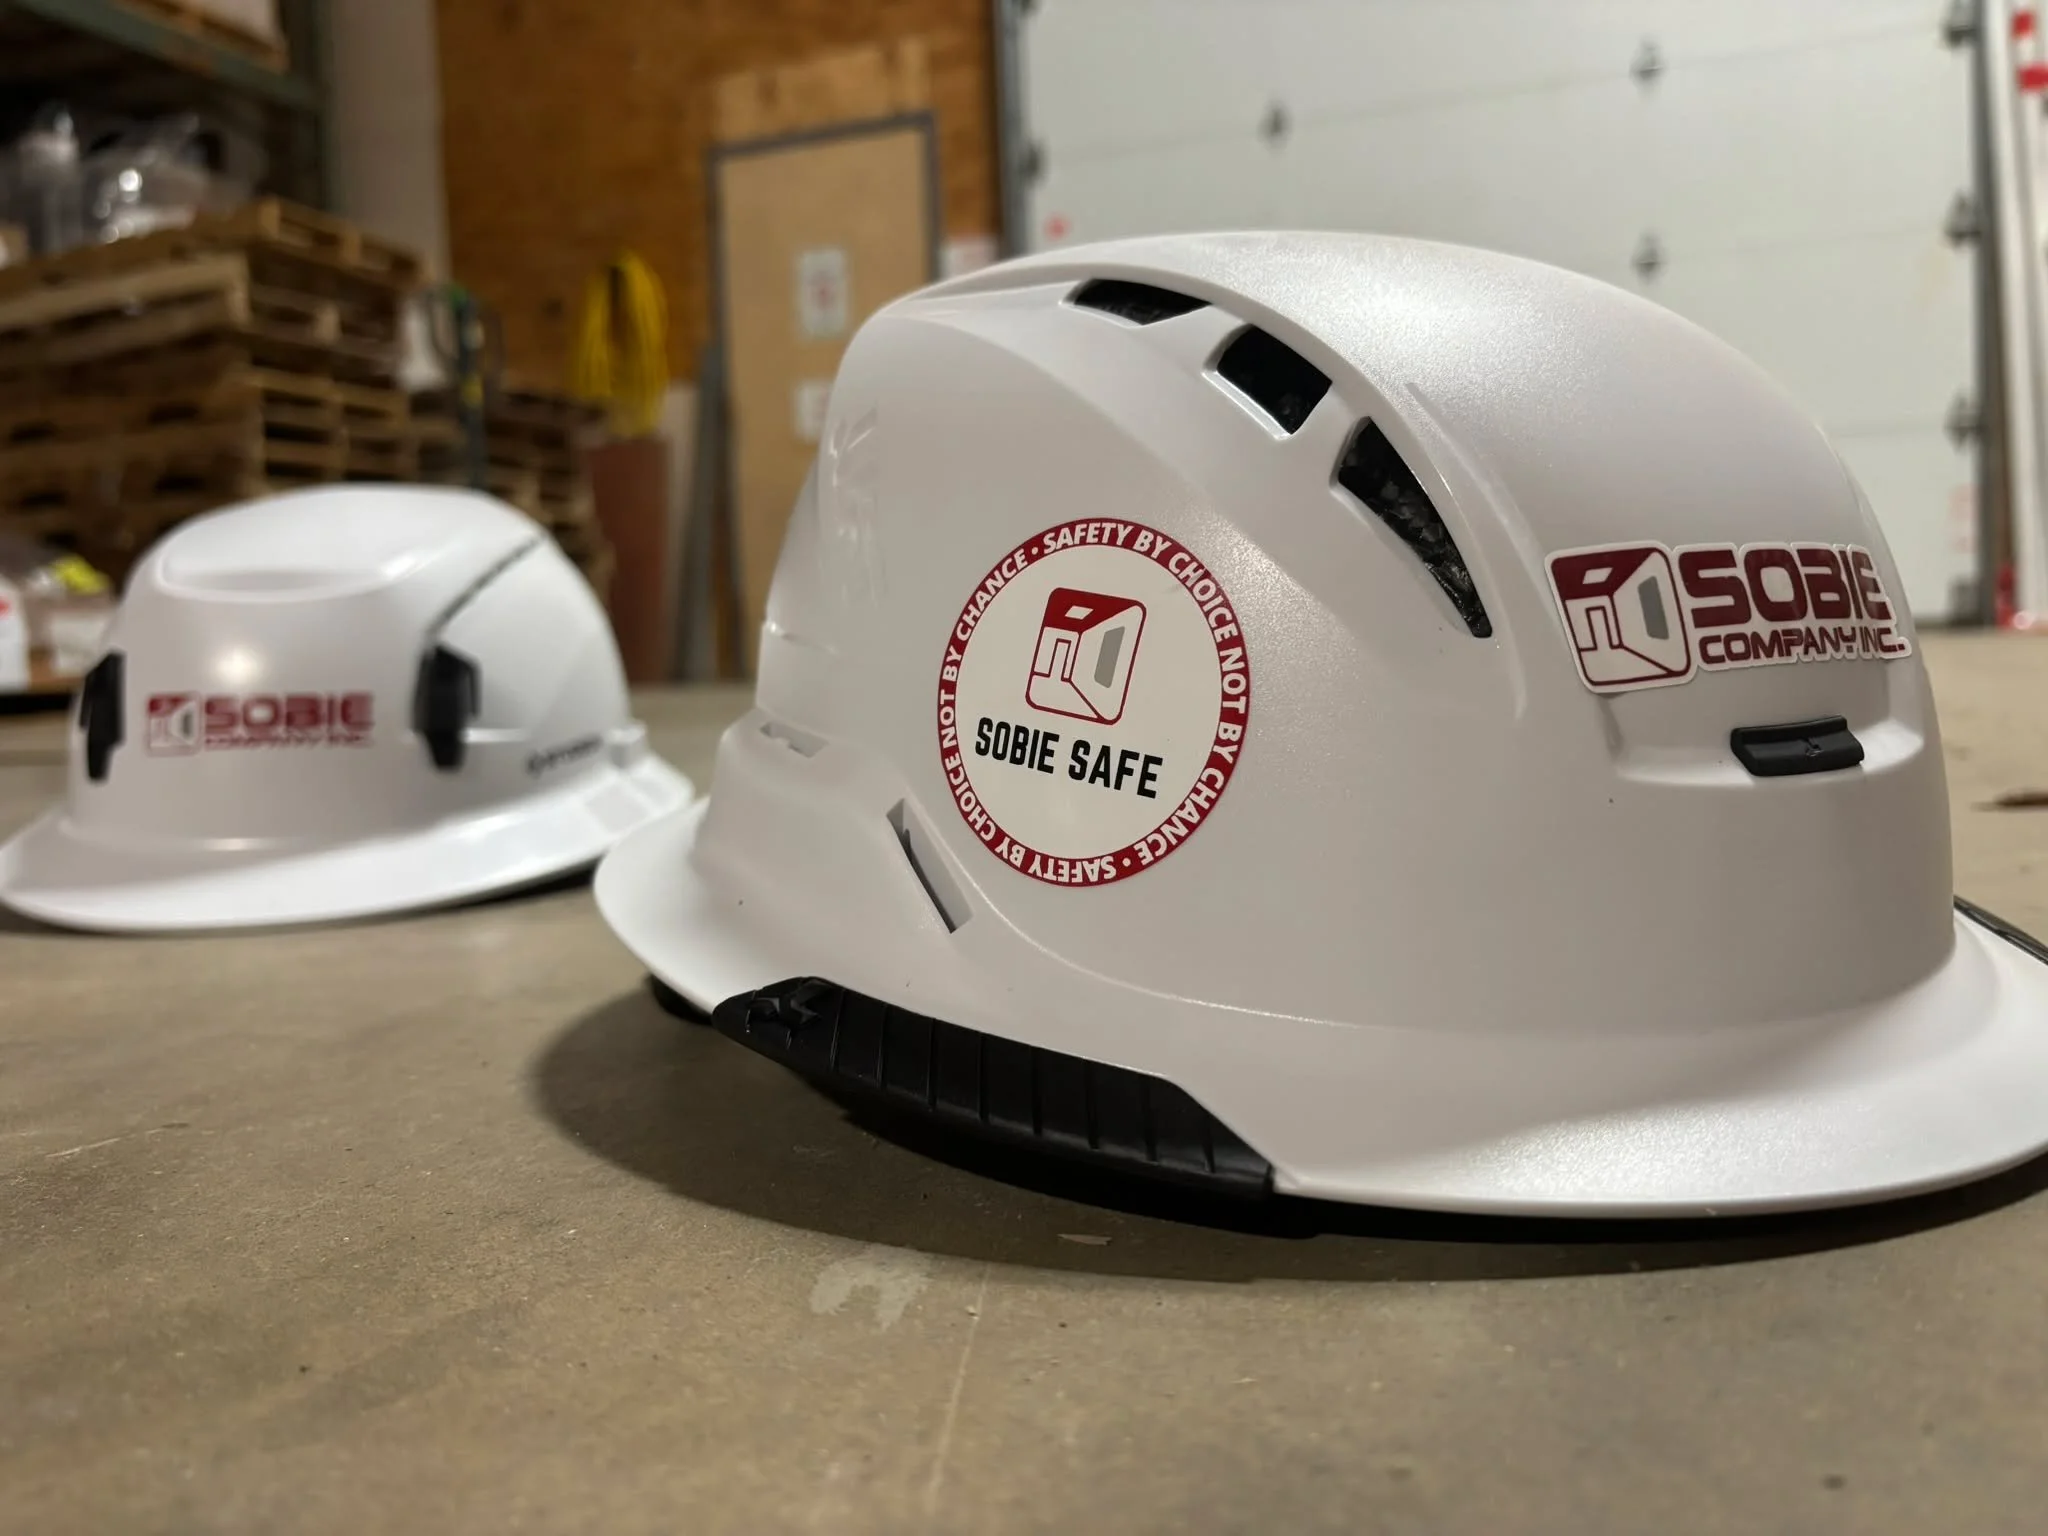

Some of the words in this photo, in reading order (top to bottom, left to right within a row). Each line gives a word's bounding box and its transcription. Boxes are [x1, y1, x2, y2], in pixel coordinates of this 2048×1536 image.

[1043, 522, 1133, 554] SAFETY
[1135, 530, 1172, 559] BY
[956, 548, 1029, 642] CHANCE
[1168, 551, 1239, 643] CHOICE
[1678, 548, 1892, 629] SOBIE
[943, 645, 962, 683] BY
[1699, 626, 1857, 665] COMPANY
[1220, 646, 1247, 714] NOT
[940, 689, 957, 746] NOT
[1213, 722, 1243, 764] BY
[974, 716, 1060, 774] SOBIE
[1068, 739, 1163, 799] SAFE
[944, 752, 996, 842] CHOICE
[1133, 767, 1225, 866] CHANCE
[994, 833, 1029, 860] BY
[1028, 855, 1117, 883] SAFETY
